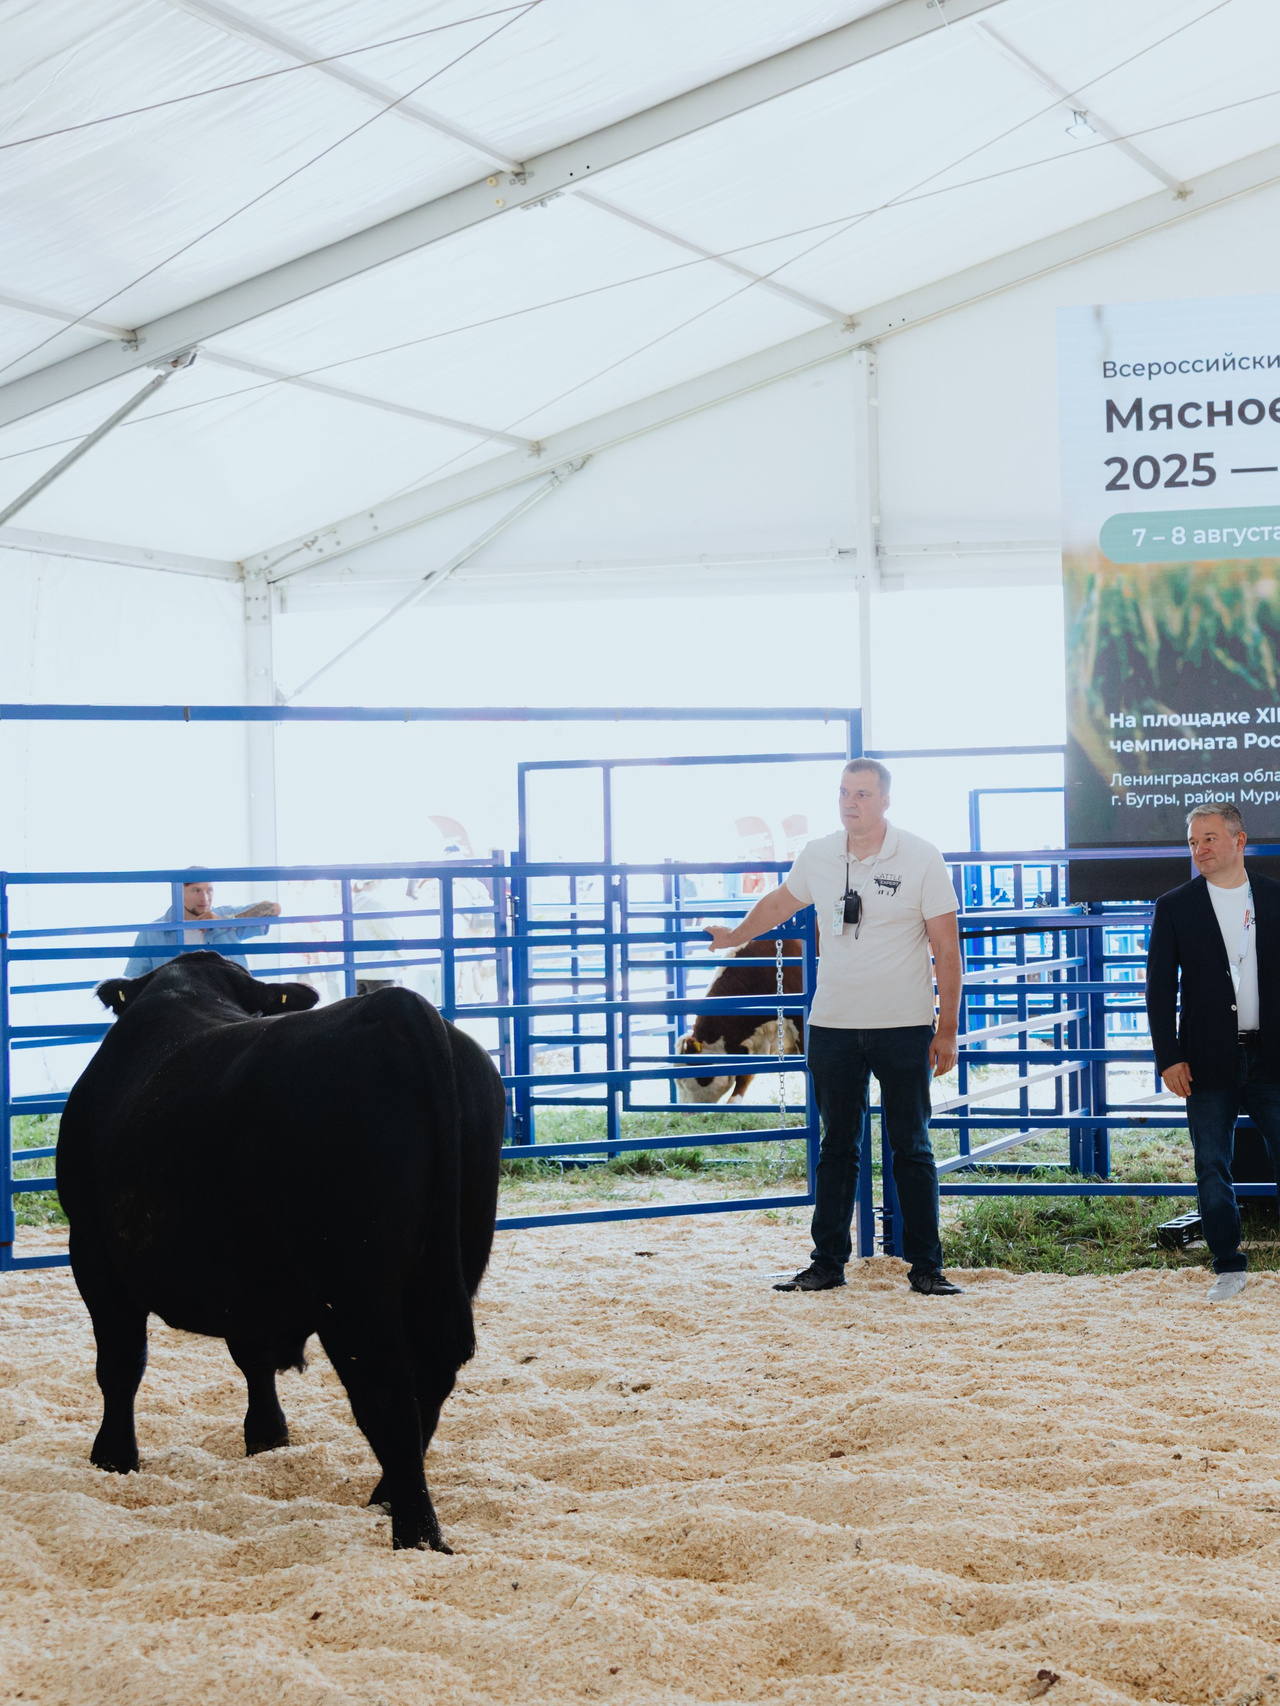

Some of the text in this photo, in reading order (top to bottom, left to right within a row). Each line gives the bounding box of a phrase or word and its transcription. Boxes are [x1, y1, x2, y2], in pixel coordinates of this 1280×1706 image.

[1104, 452, 1218, 492] 2025
[1132, 528, 1147, 547] 7
[1171, 526, 1187, 545] 8
[1109, 713, 1137, 729] На
[1142, 711, 1251, 728] площадке
[1109, 736, 1238, 753] чемпионата
[1109, 772, 1239, 788] Ленинградская
[1111, 795, 1121, 806] г.
[1126, 792, 1181, 808] Бугры,
[1184, 789, 1236, 806] район
